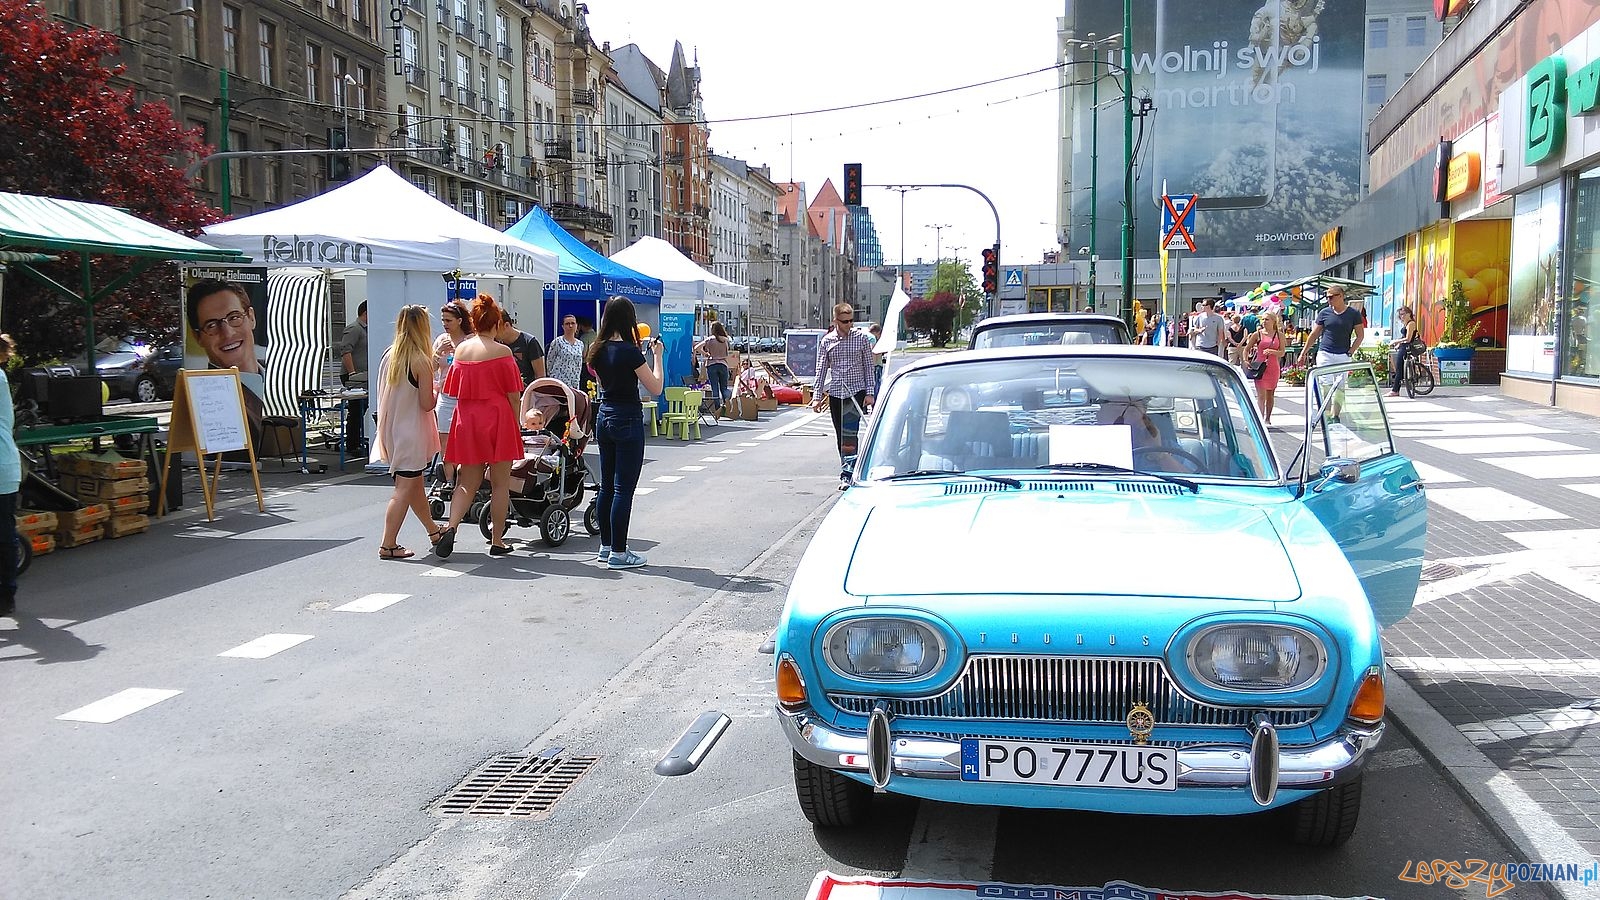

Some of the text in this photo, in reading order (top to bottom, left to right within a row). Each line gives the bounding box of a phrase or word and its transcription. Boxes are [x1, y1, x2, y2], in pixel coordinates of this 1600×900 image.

[1107, 41, 1228, 80] Uwolnij
[979, 632, 1150, 646] TAUNUS
[964, 764, 978, 774] PL
[985, 744, 1168, 785] PO 777US
